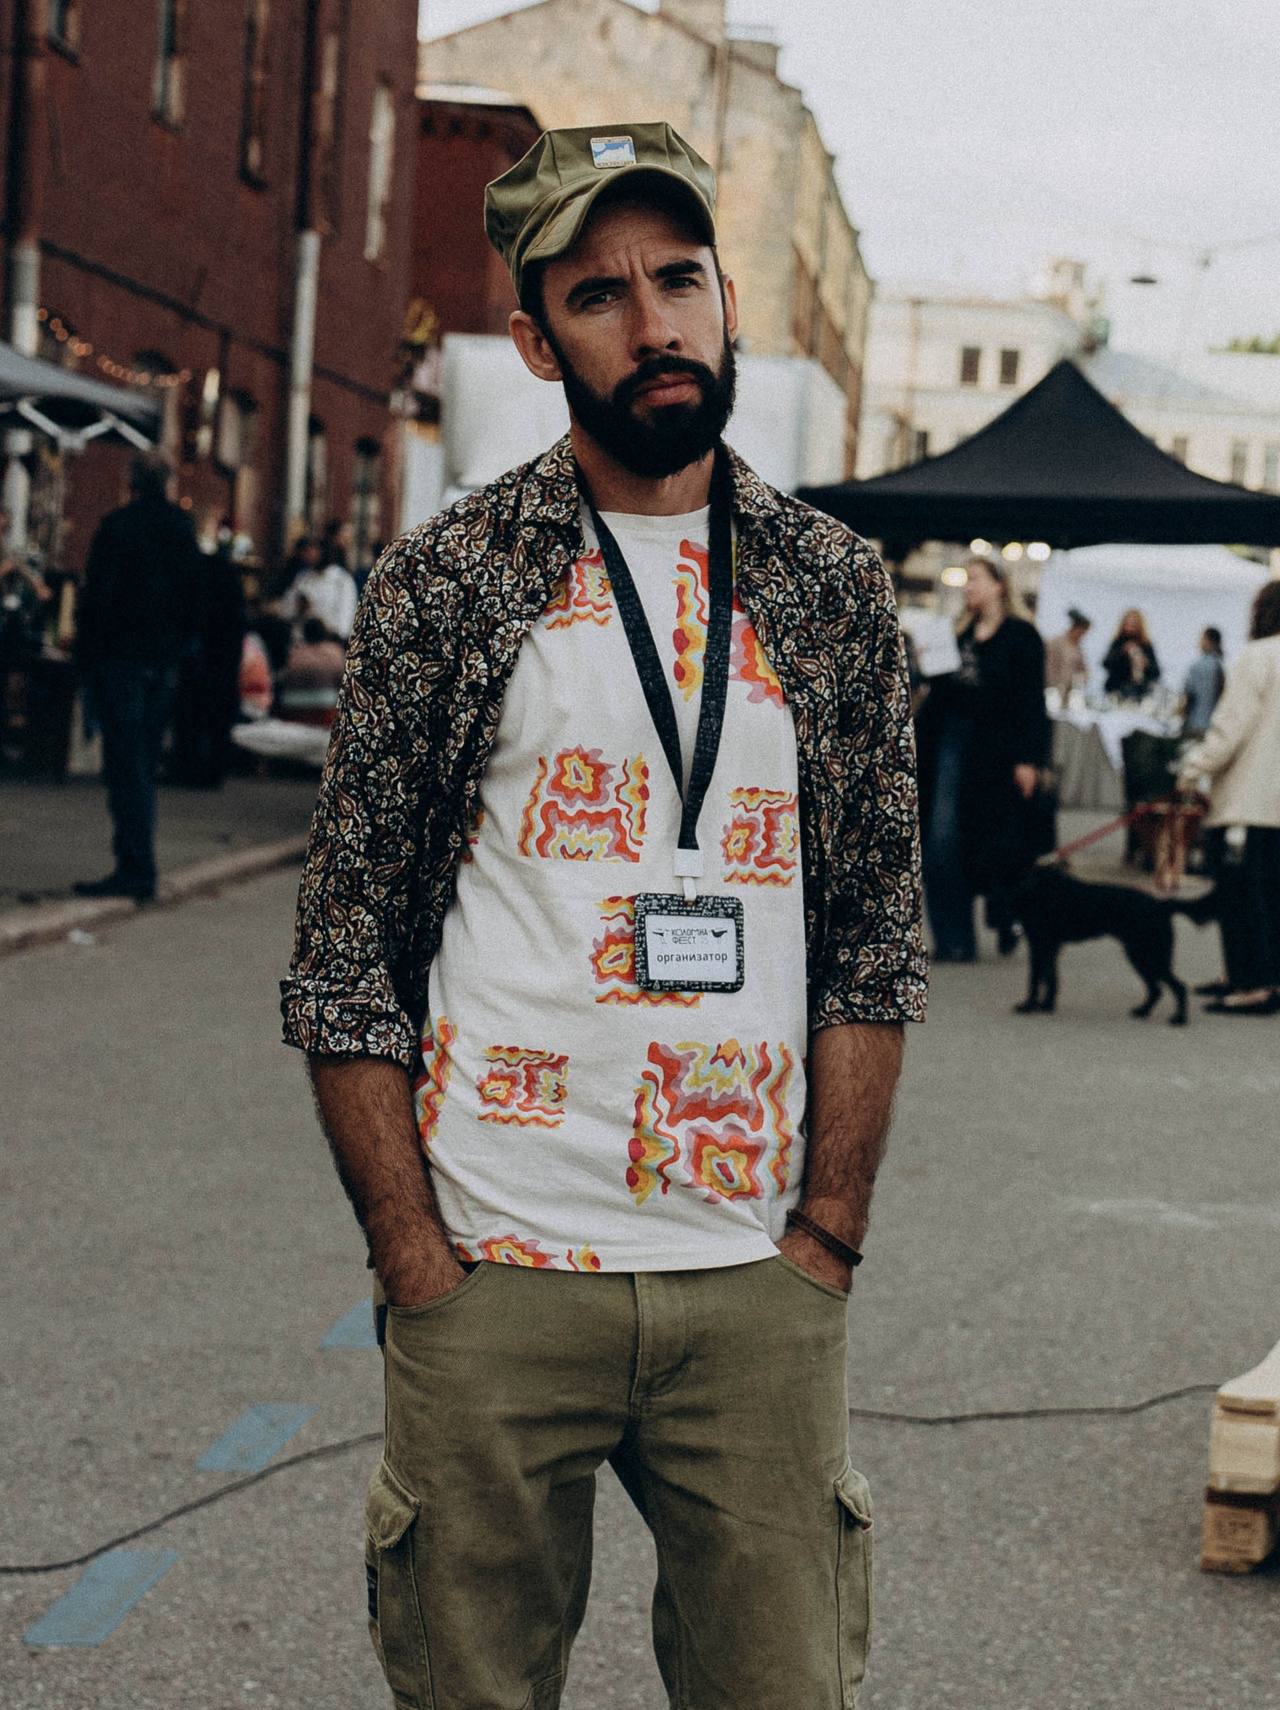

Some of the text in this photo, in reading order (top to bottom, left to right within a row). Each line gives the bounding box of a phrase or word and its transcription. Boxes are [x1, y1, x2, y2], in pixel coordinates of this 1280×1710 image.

[671, 928, 709, 936] КОЛОМНА
[671, 936, 697, 945] ФЕСТ
[657, 953, 728, 964] организатор
